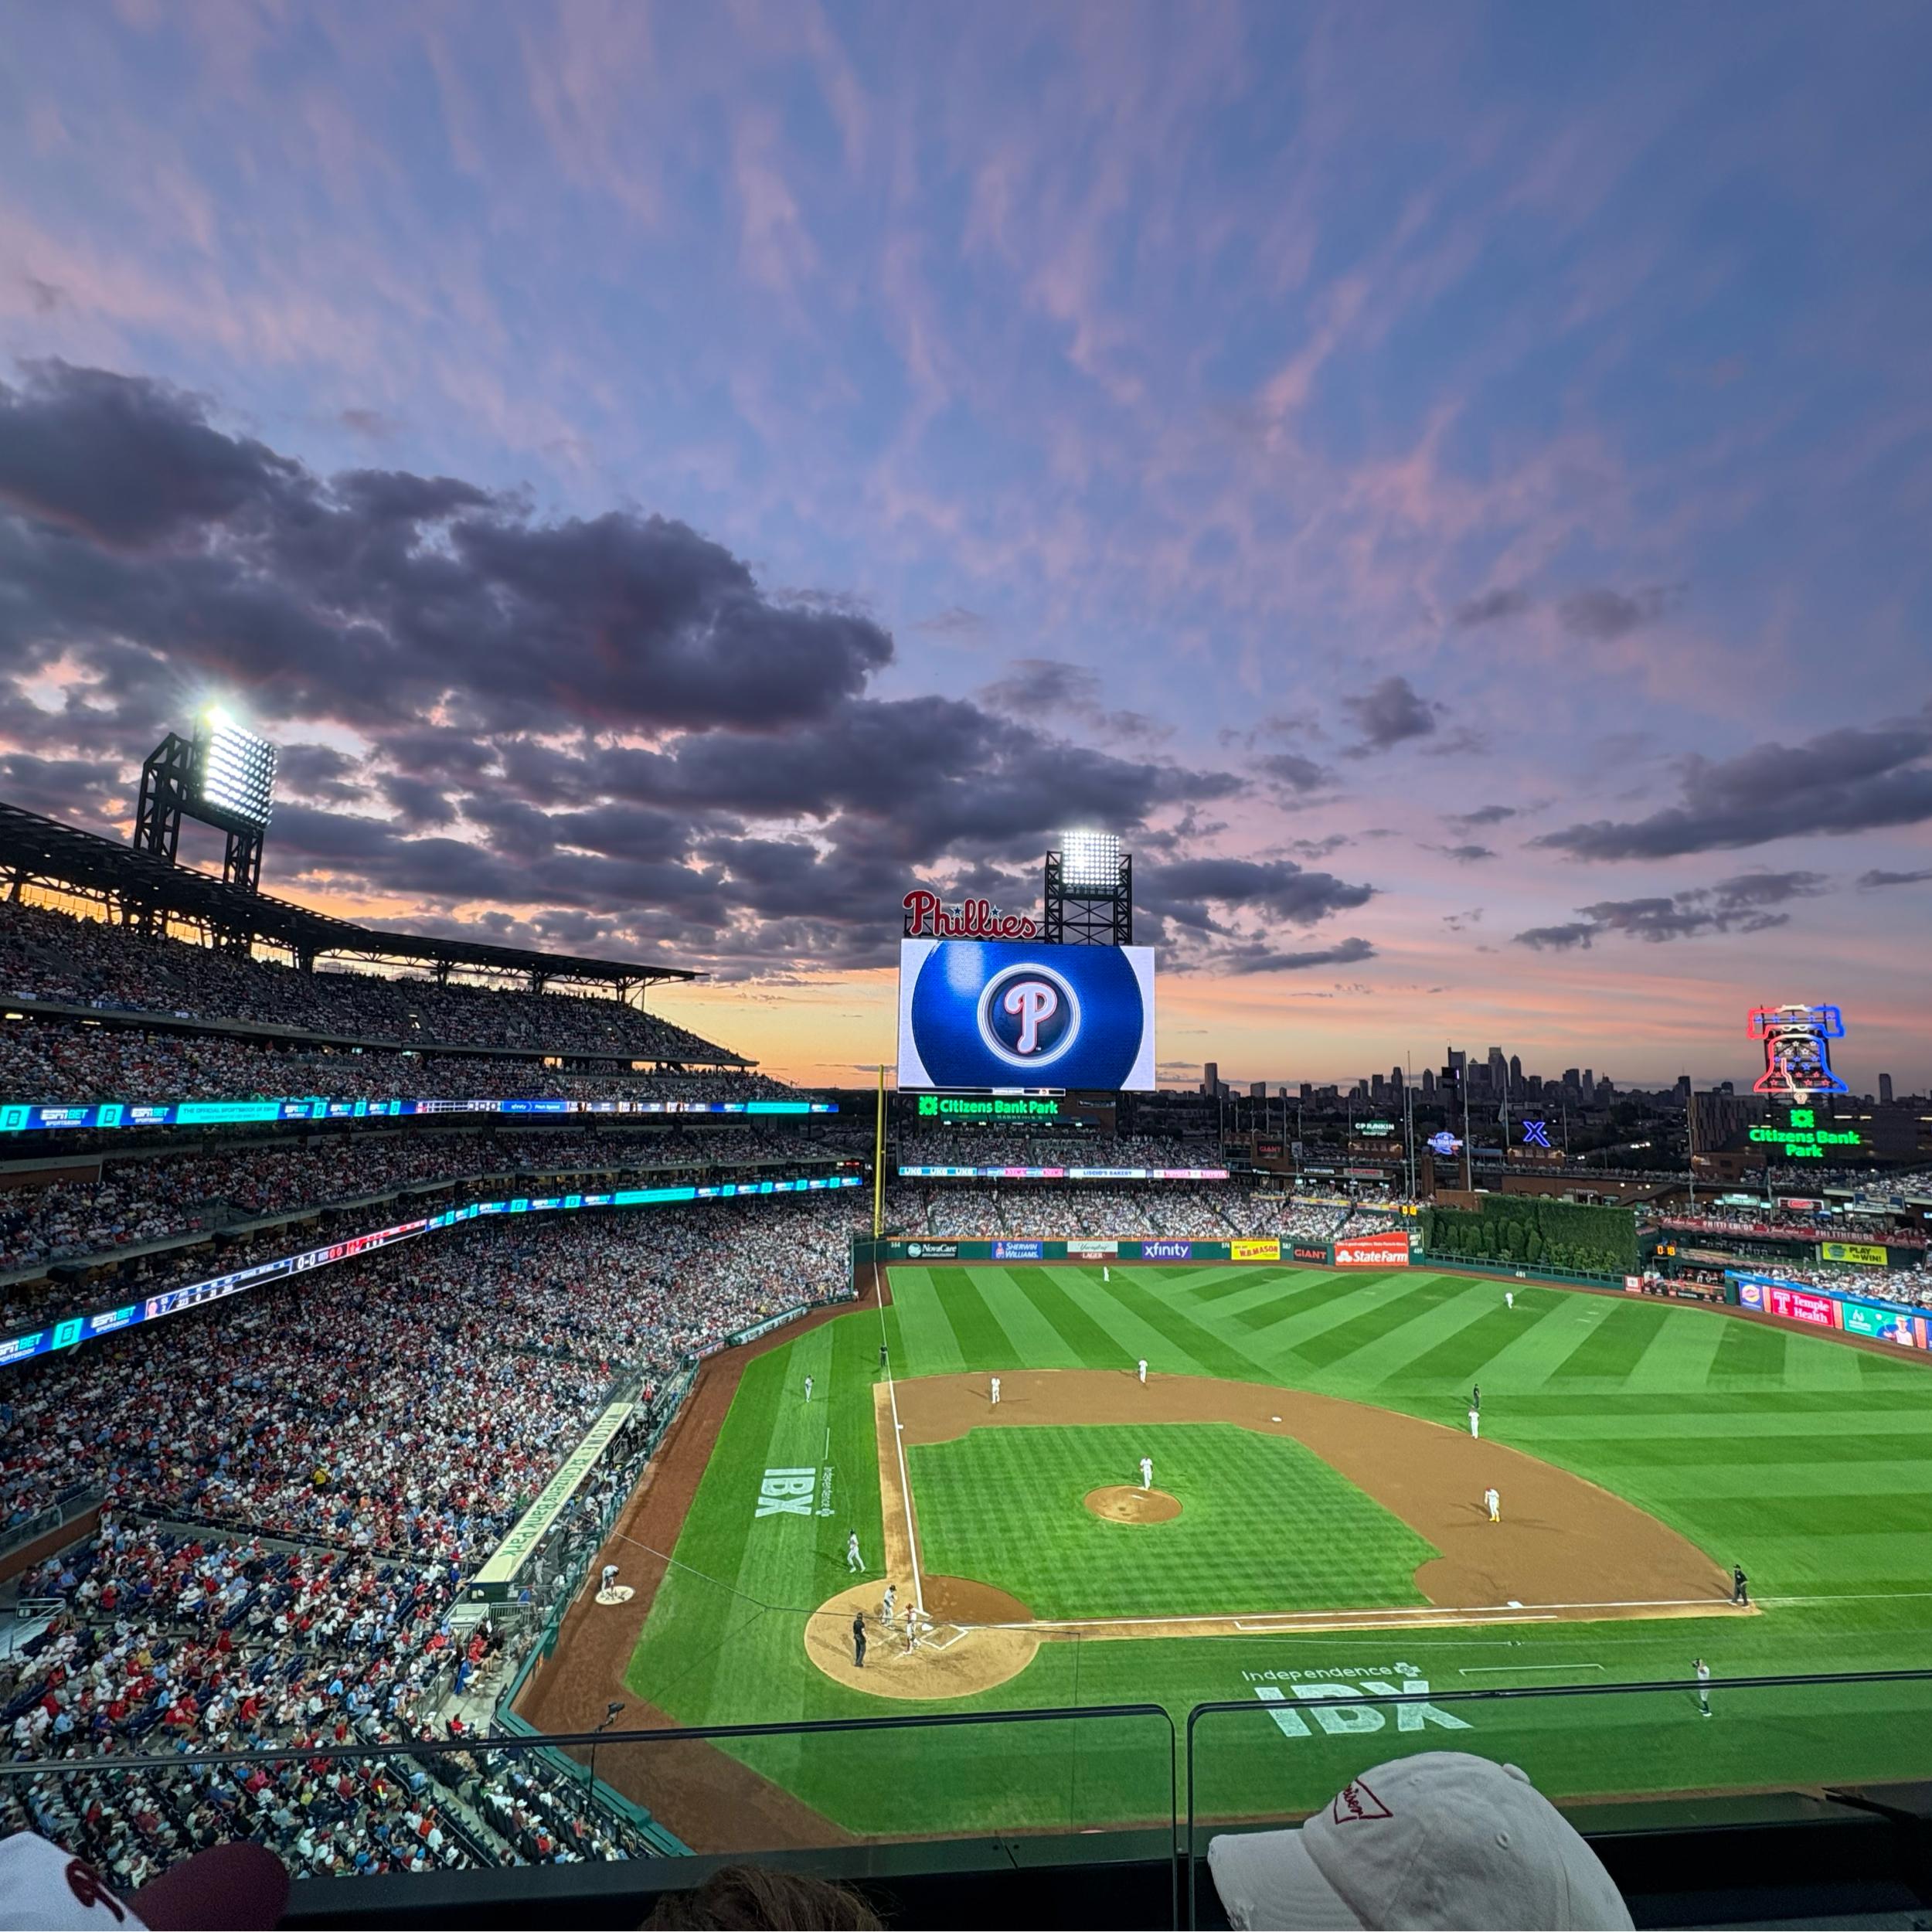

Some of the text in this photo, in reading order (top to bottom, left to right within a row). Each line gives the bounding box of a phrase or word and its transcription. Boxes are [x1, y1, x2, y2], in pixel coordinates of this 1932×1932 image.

[903, 890, 1037, 938] Phillies
[1004, 981, 1057, 1053] P
[940, 1100, 1058, 1114] Citizens Bank Park
[1750, 1129, 1861, 1144] Citizens Bank
[1786, 1144, 1823, 1157] Park
[922, 1243, 957, 1252] NovaCare
[1145, 1243, 1189, 1257] xfinity
[1294, 1249, 1327, 1260] GIANT
[1792, 1294, 1830, 1312] Temple
[91, 1306, 136, 1328] ESPN BET
[1794, 1308, 1828, 1324] Health
[96, 1318, 130, 1333] SPORTSBOOK
[581, 1413, 622, 1451] WELCOME
[755, 1468, 816, 1518] IBX
[498, 1466, 583, 1557] Citizens Bank Park
[1242, 1664, 1393, 1682] Independence
[1254, 1681, 1475, 1737] IBX
